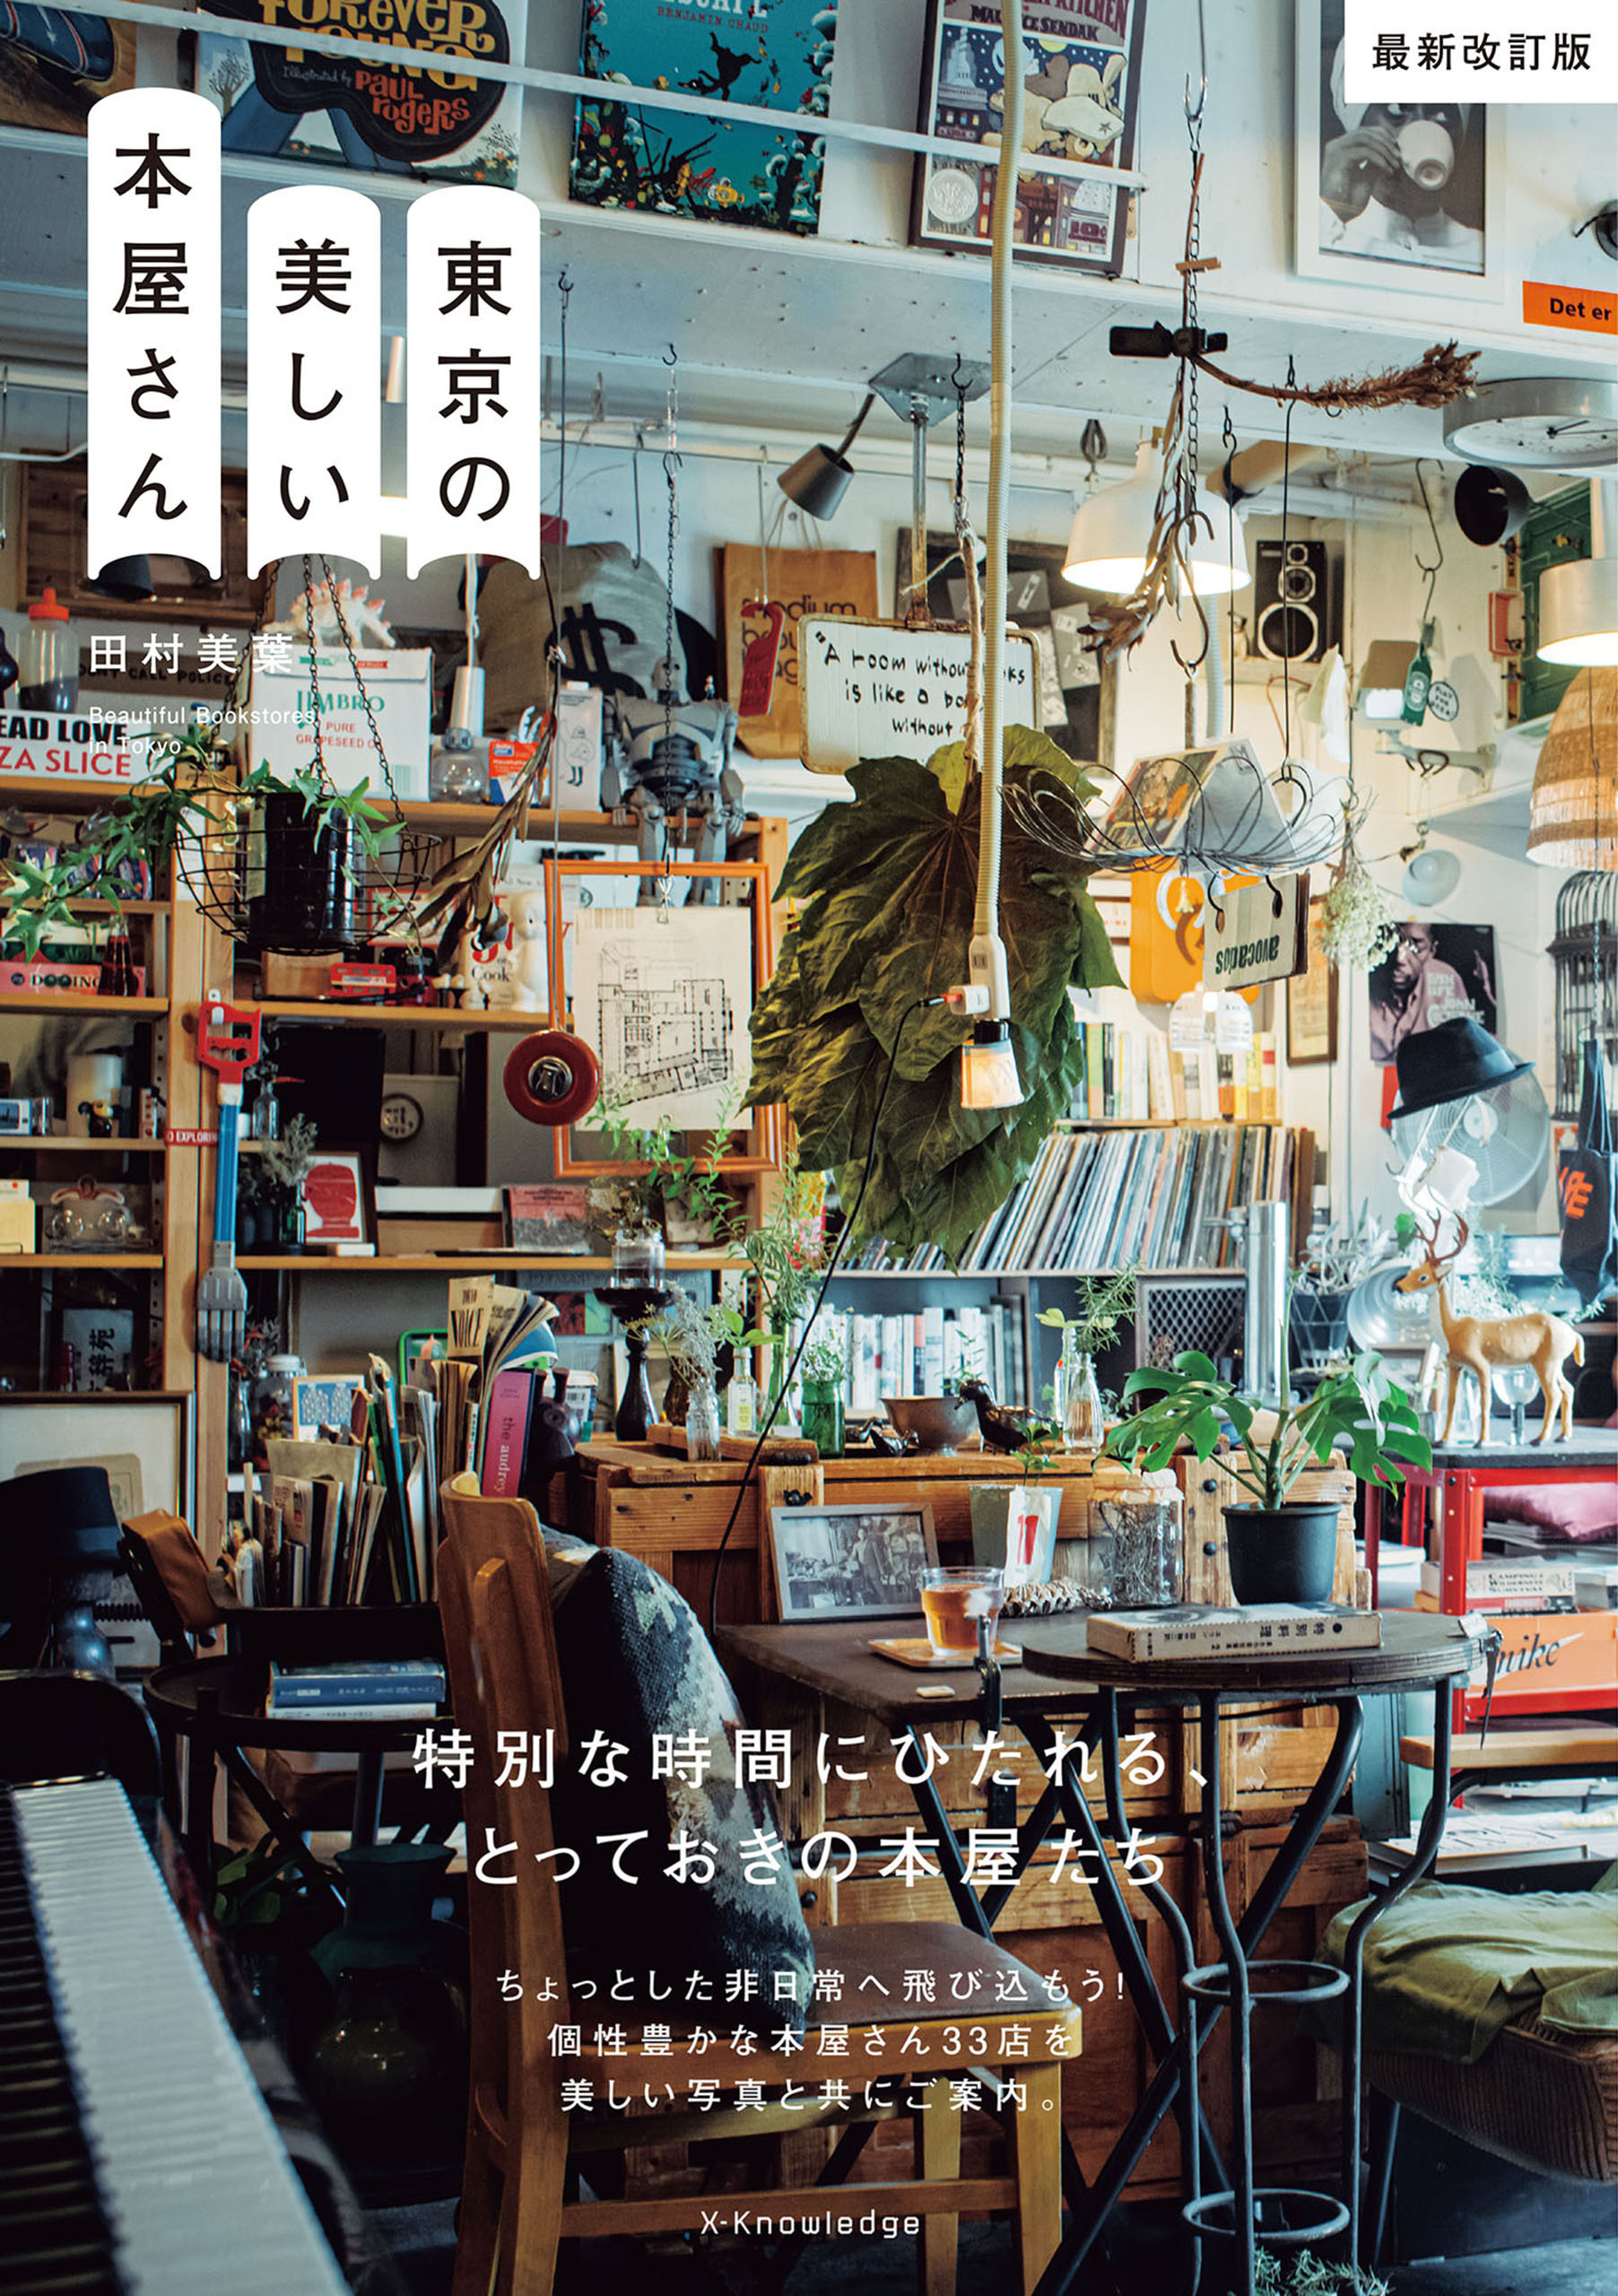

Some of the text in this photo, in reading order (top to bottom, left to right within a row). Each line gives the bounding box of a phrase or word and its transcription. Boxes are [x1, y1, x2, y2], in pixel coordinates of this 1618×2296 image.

[657, 5, 722, 26] BENJAMIN
[728, 18, 769, 34] CHAUD
[971, 5, 1099, 42] MAUCE SENDAK
[1549, 297, 1613, 321] Det er
[852, 649, 906, 672] room
[846, 679, 862, 704] is
[873, 683, 906, 704] like
[918, 688, 929, 705] a
[58, 718, 129, 747] LOVE
[326, 721, 357, 734] PURE
[892, 718, 953, 737] without
[295, 734, 365, 749] GRPESEED
[45, 749, 132, 778] SLICE
[1214, 934, 1281, 975] avocados
[493, 1444, 510, 1495] audrey
